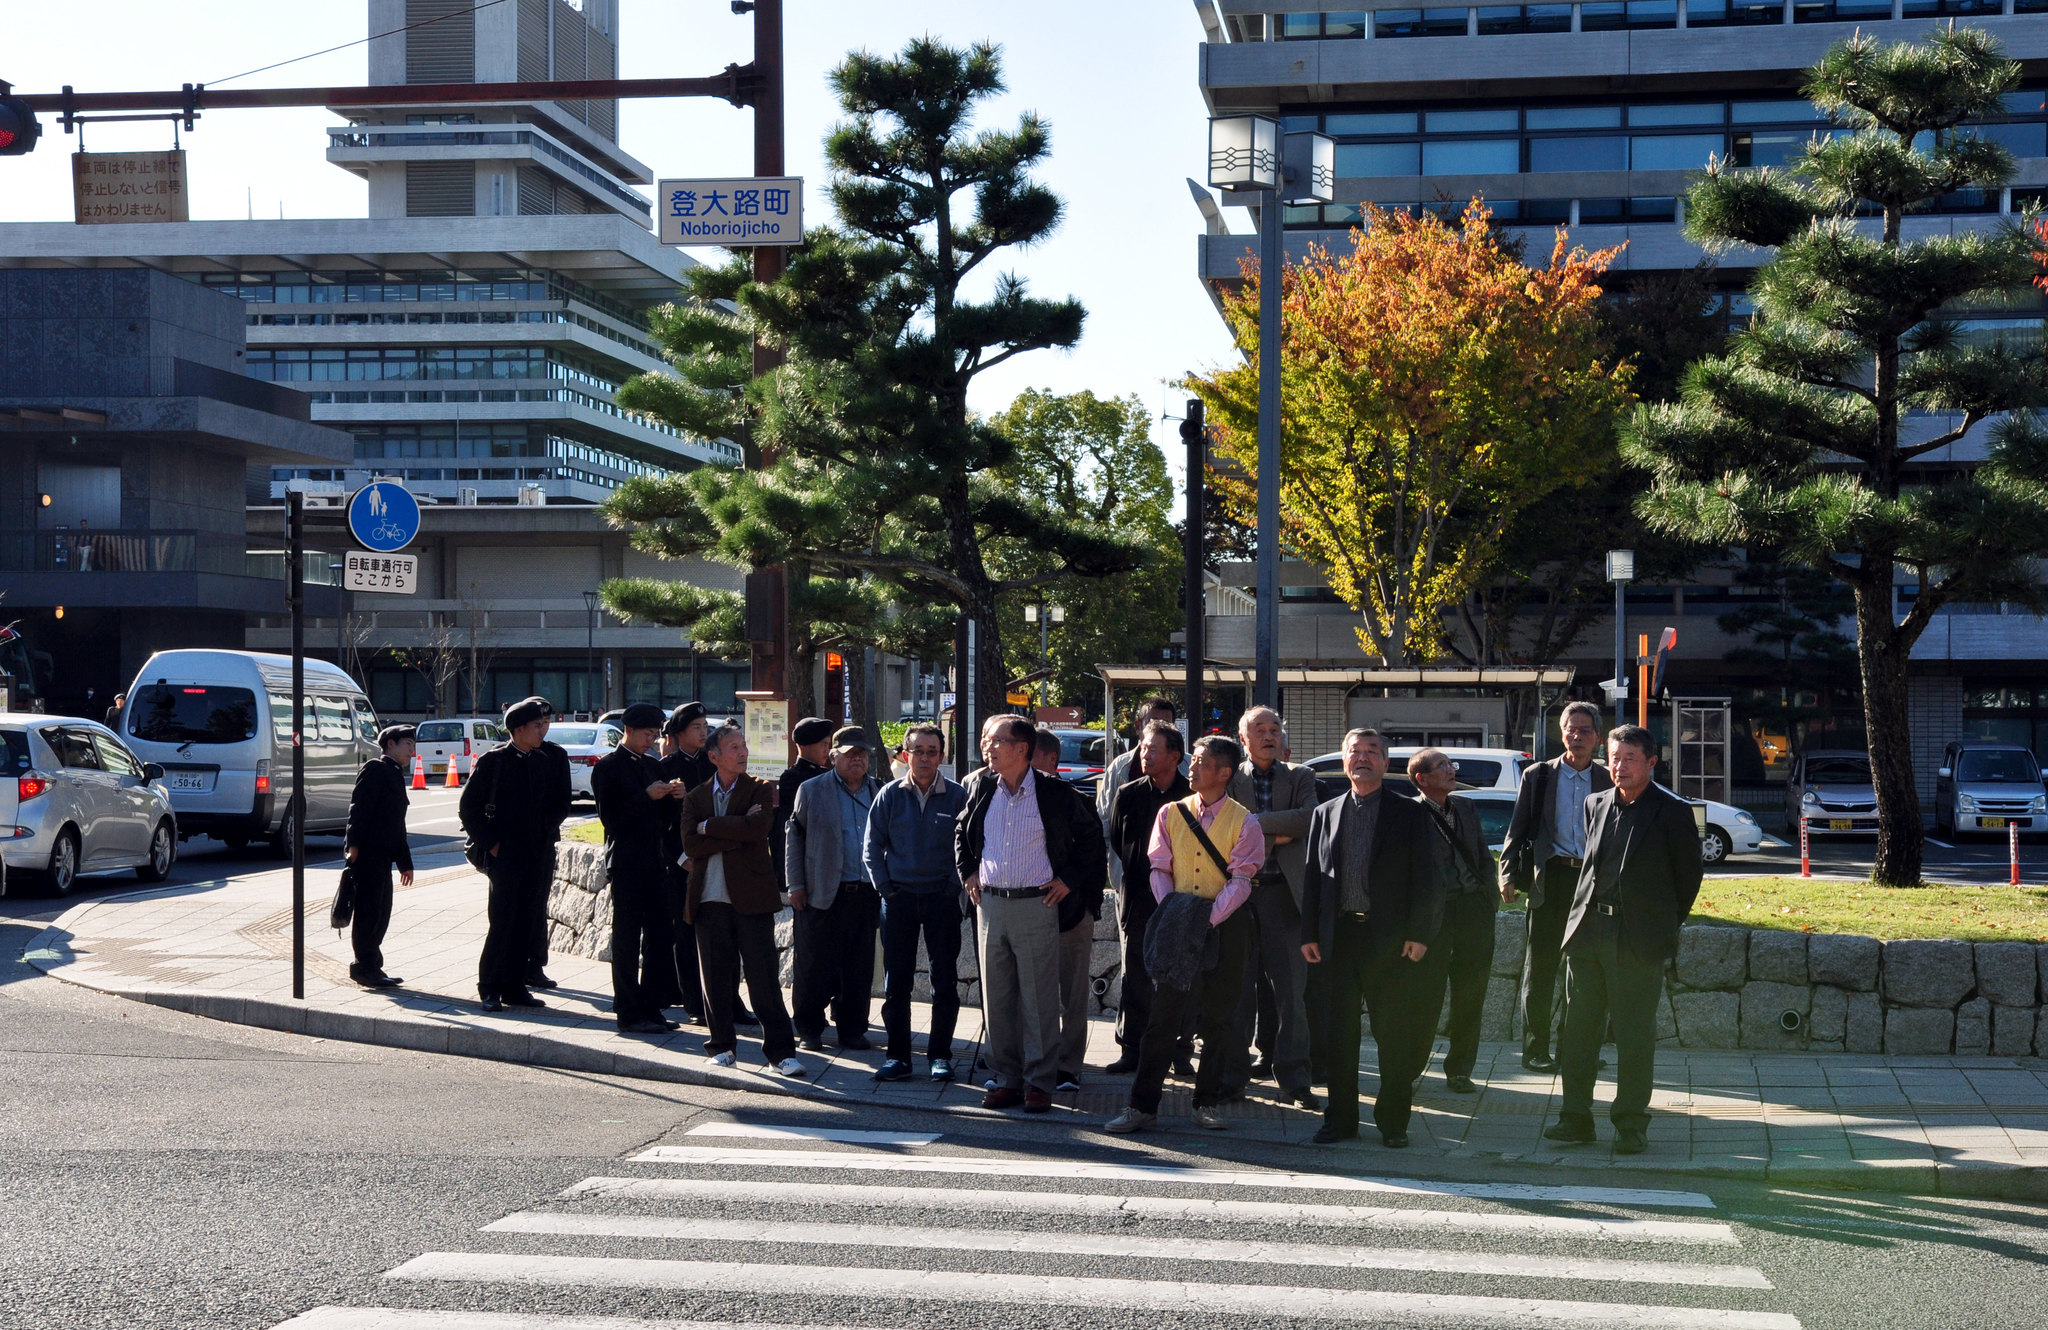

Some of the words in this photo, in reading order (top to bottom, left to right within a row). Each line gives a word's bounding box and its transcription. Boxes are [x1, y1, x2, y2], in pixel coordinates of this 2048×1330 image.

[80, 159, 181, 175] 車両は停止線で
[80, 180, 182, 196] 停止しないと信号
[80, 202, 167, 217] はかわりません
[670, 188, 791, 217] 登大路町
[680, 219, 781, 238] Noboriojicho
[348, 556, 414, 574] 自転車通行可
[354, 572, 405, 588] ここから
[178, 778, 202, 788] 50-66
